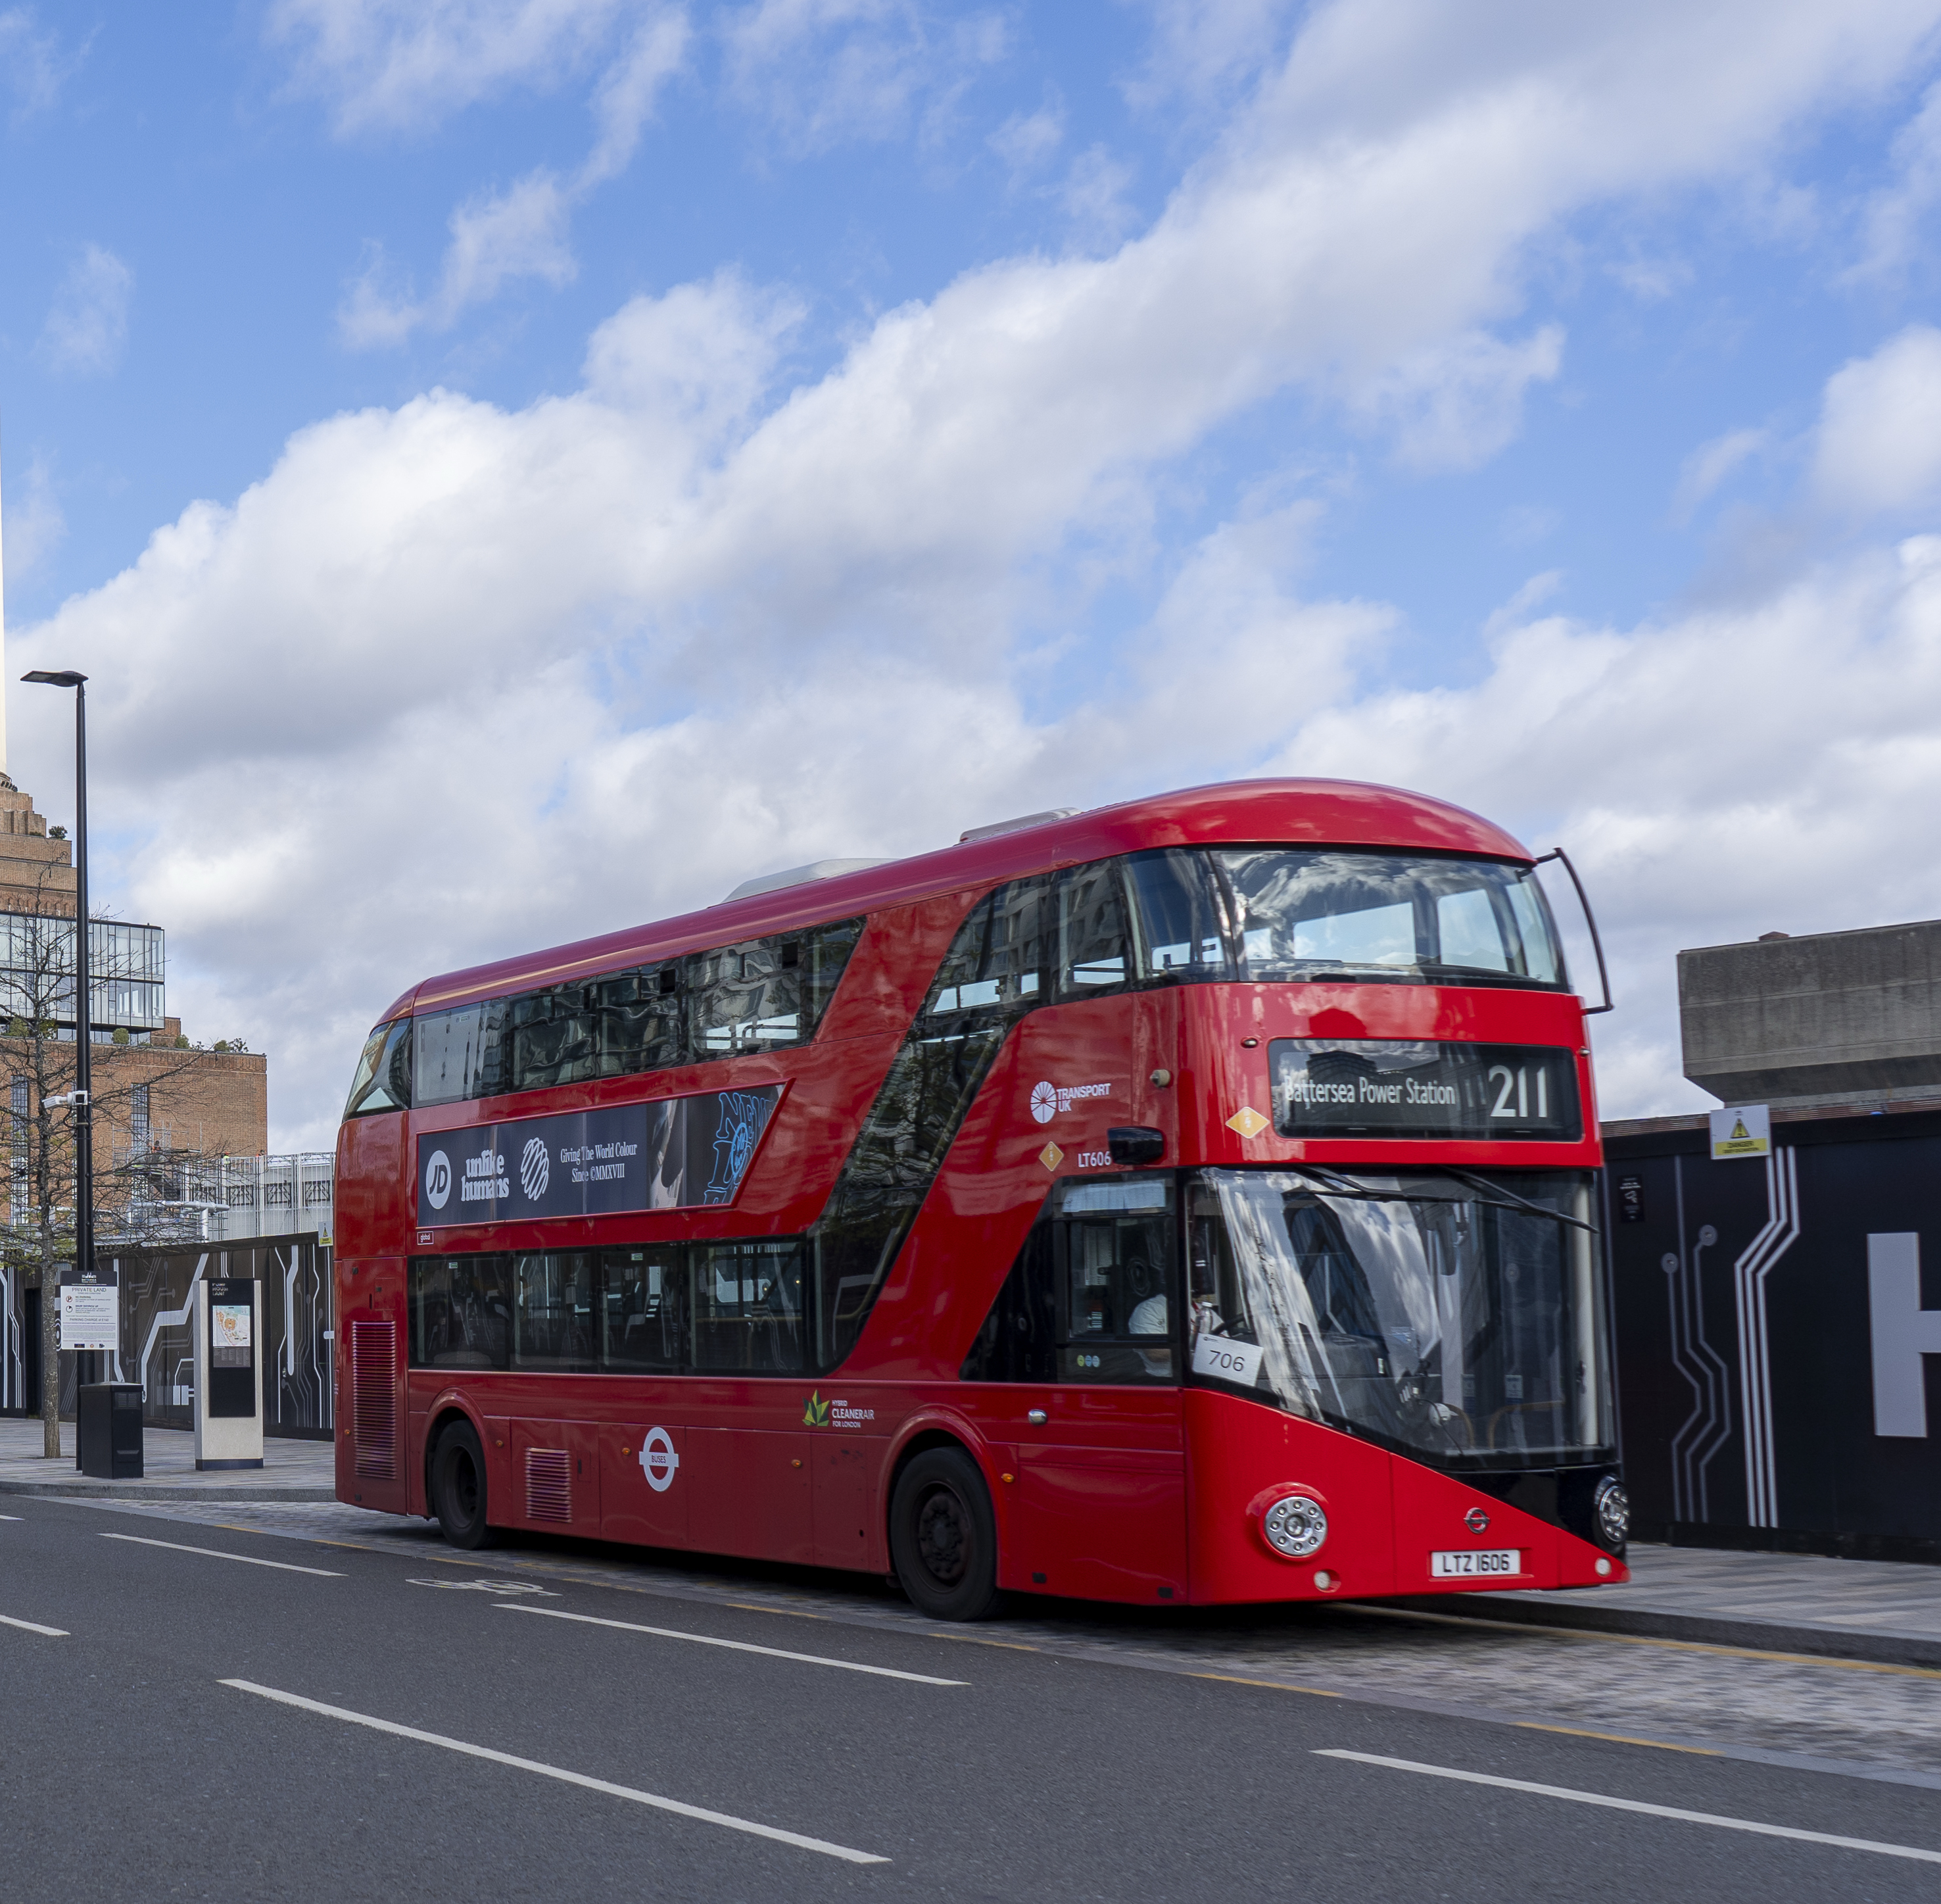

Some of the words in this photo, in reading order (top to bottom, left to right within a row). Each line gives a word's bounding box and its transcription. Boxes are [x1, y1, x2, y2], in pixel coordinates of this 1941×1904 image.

[1056, 1083, 1112, 1100] TRANSPORT
[1284, 1075, 1356, 1104] Battersea
[1359, 1077, 1403, 1104] Power
[1406, 1077, 1456, 1104] Station
[1488, 1065, 1548, 1118] 211
[1058, 1100, 1072, 1112] UK
[466, 1150, 505, 1178] unlike
[560, 1148, 581, 1165] Giving
[581, 1146, 594, 1161] The
[595, 1143, 615, 1159] World
[615, 1141, 638, 1157] Colour
[1078, 1151, 1112, 1168] LT606
[429, 1164, 448, 1195] JD
[571, 1168, 589, 1183] Since
[461, 1175, 510, 1202] humans
[1209, 1350, 1245, 1372] 706
[651, 1455, 666, 1464] BUSES
[1442, 1554, 1472, 1573] LTZ
[1475, 1553, 1510, 1573] 1606
